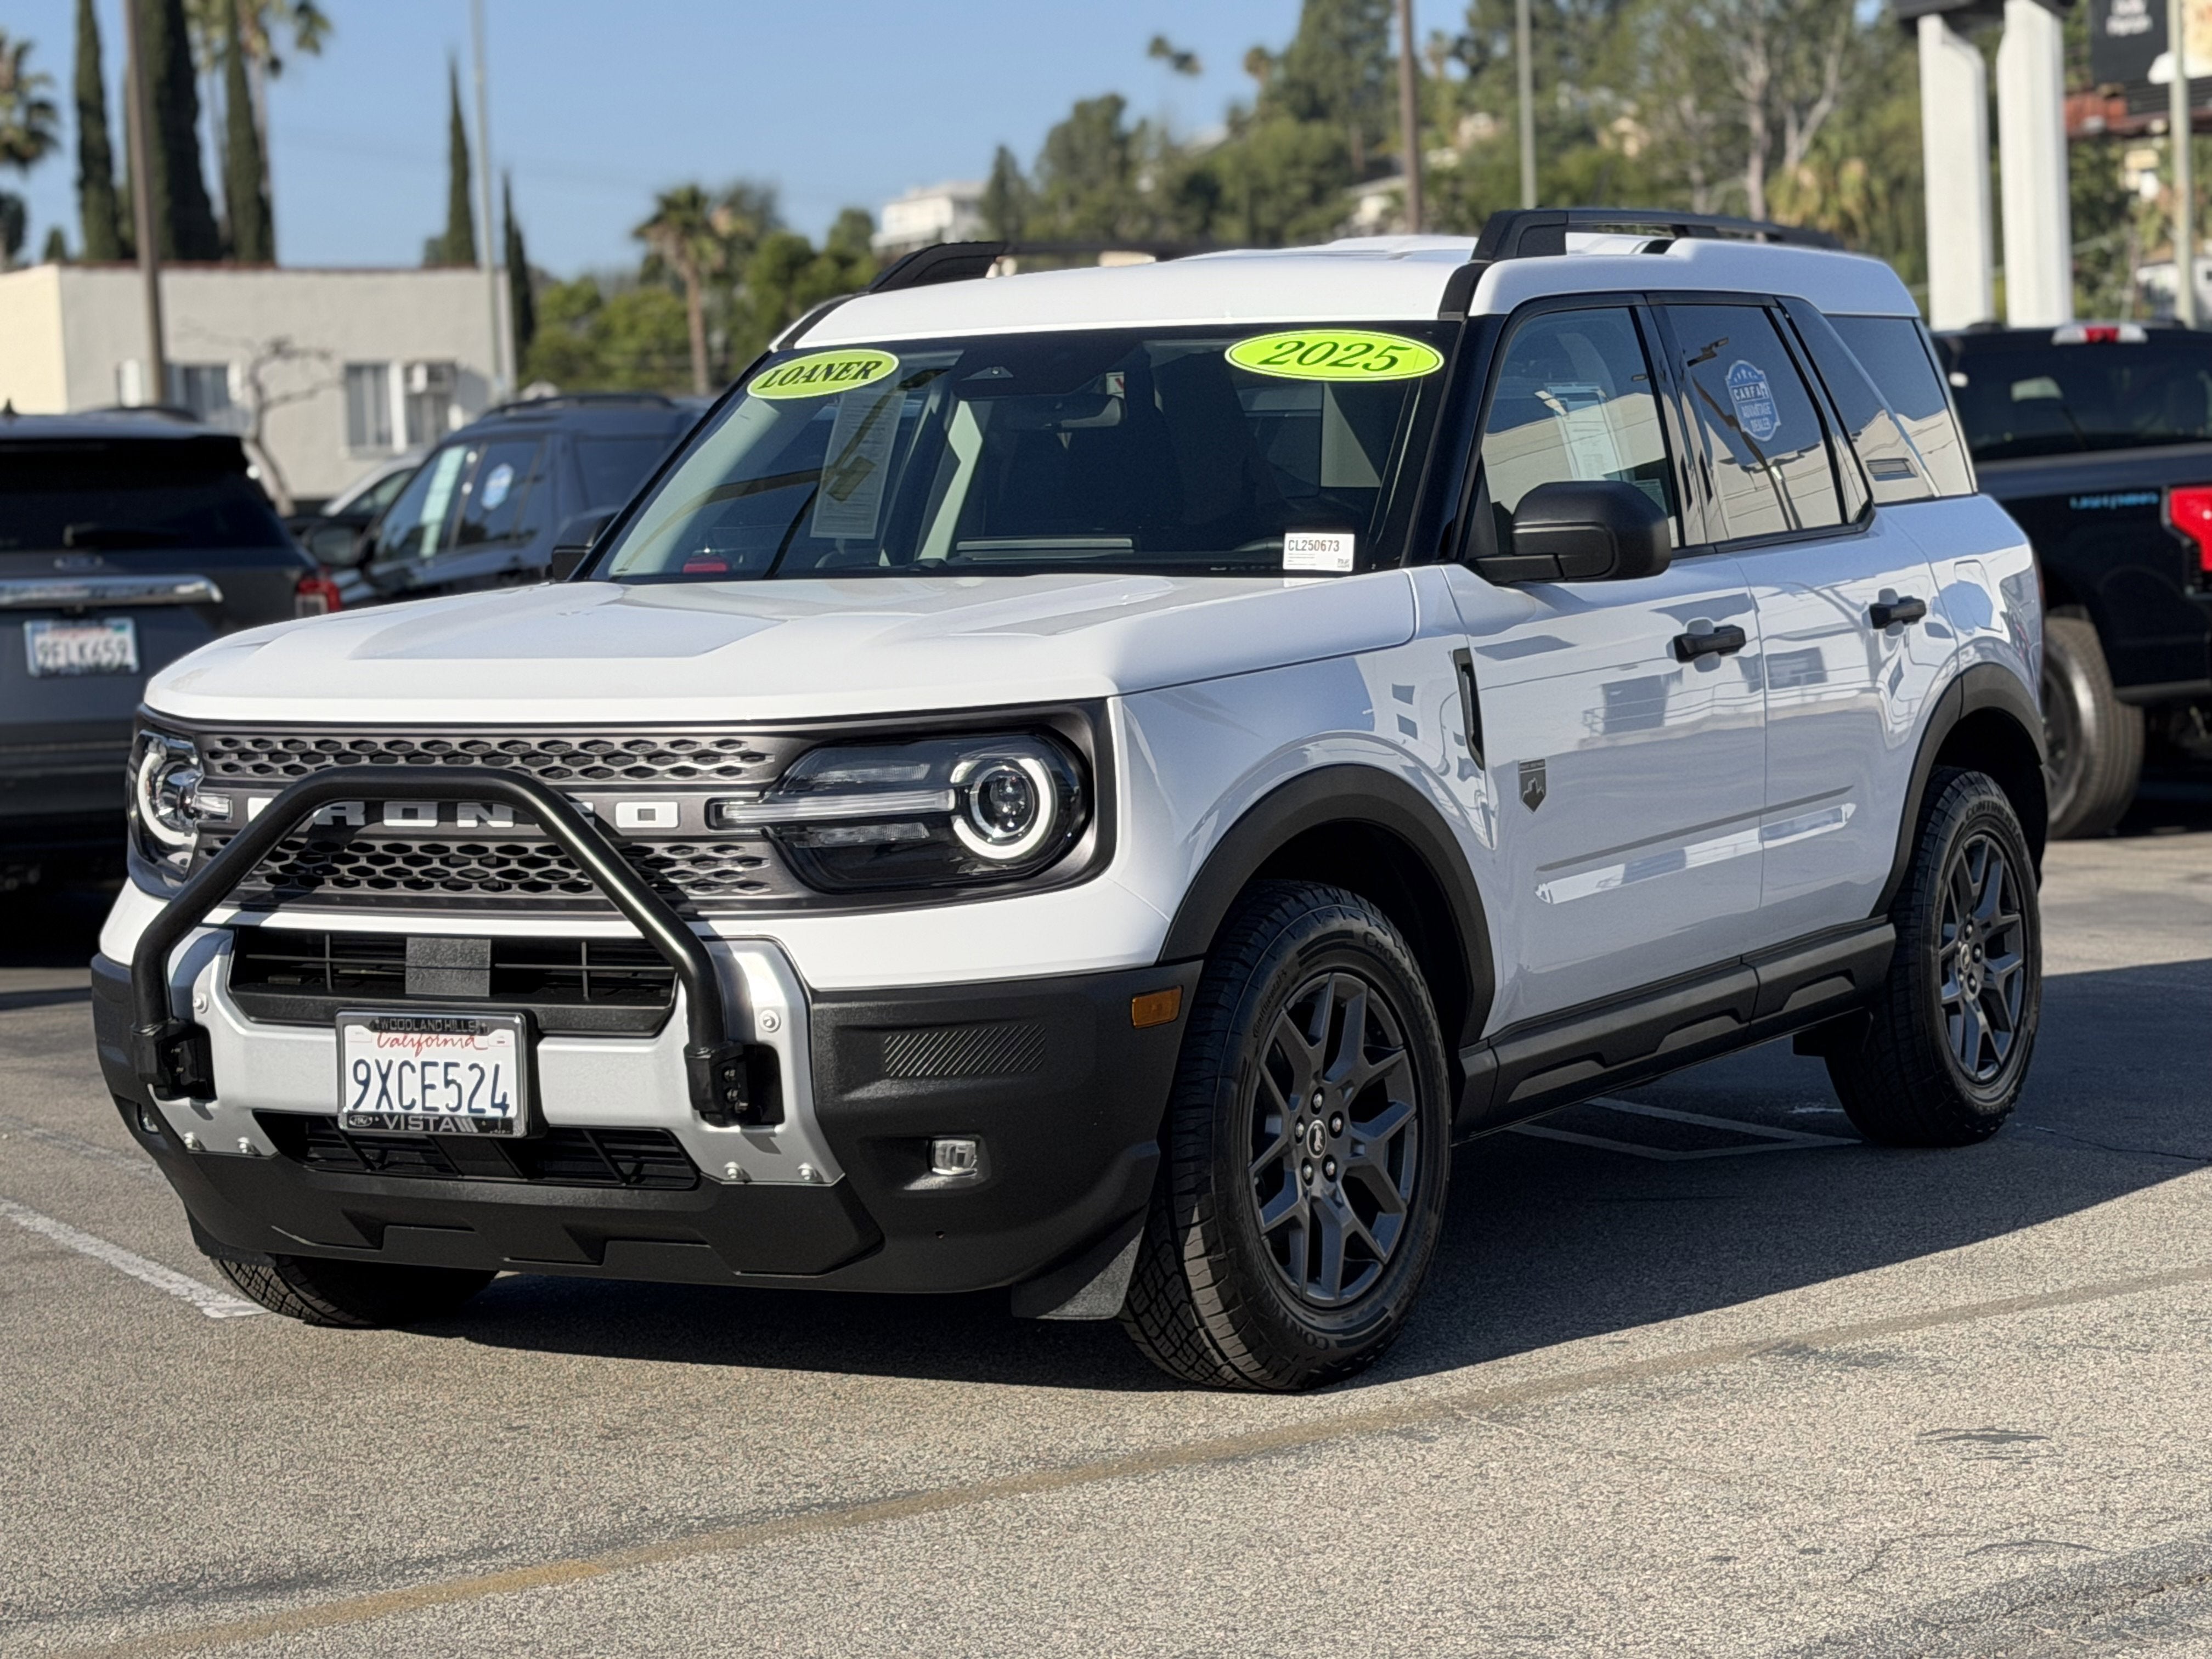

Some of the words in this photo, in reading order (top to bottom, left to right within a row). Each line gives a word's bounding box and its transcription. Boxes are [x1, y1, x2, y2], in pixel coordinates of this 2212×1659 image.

[1257, 340, 1413, 372] 2025
[757, 360, 883, 390] LOANER
[1288, 539, 1340, 552] CL250673
[247, 797, 679, 828] RONO
[381, 1018, 443, 1032] WOODLAND
[444, 1019, 476, 1032] HILLS
[376, 1031, 488, 1057] California
[352, 1058, 510, 1116] 9XCE524
[383, 1113, 458, 1133] VISTA
